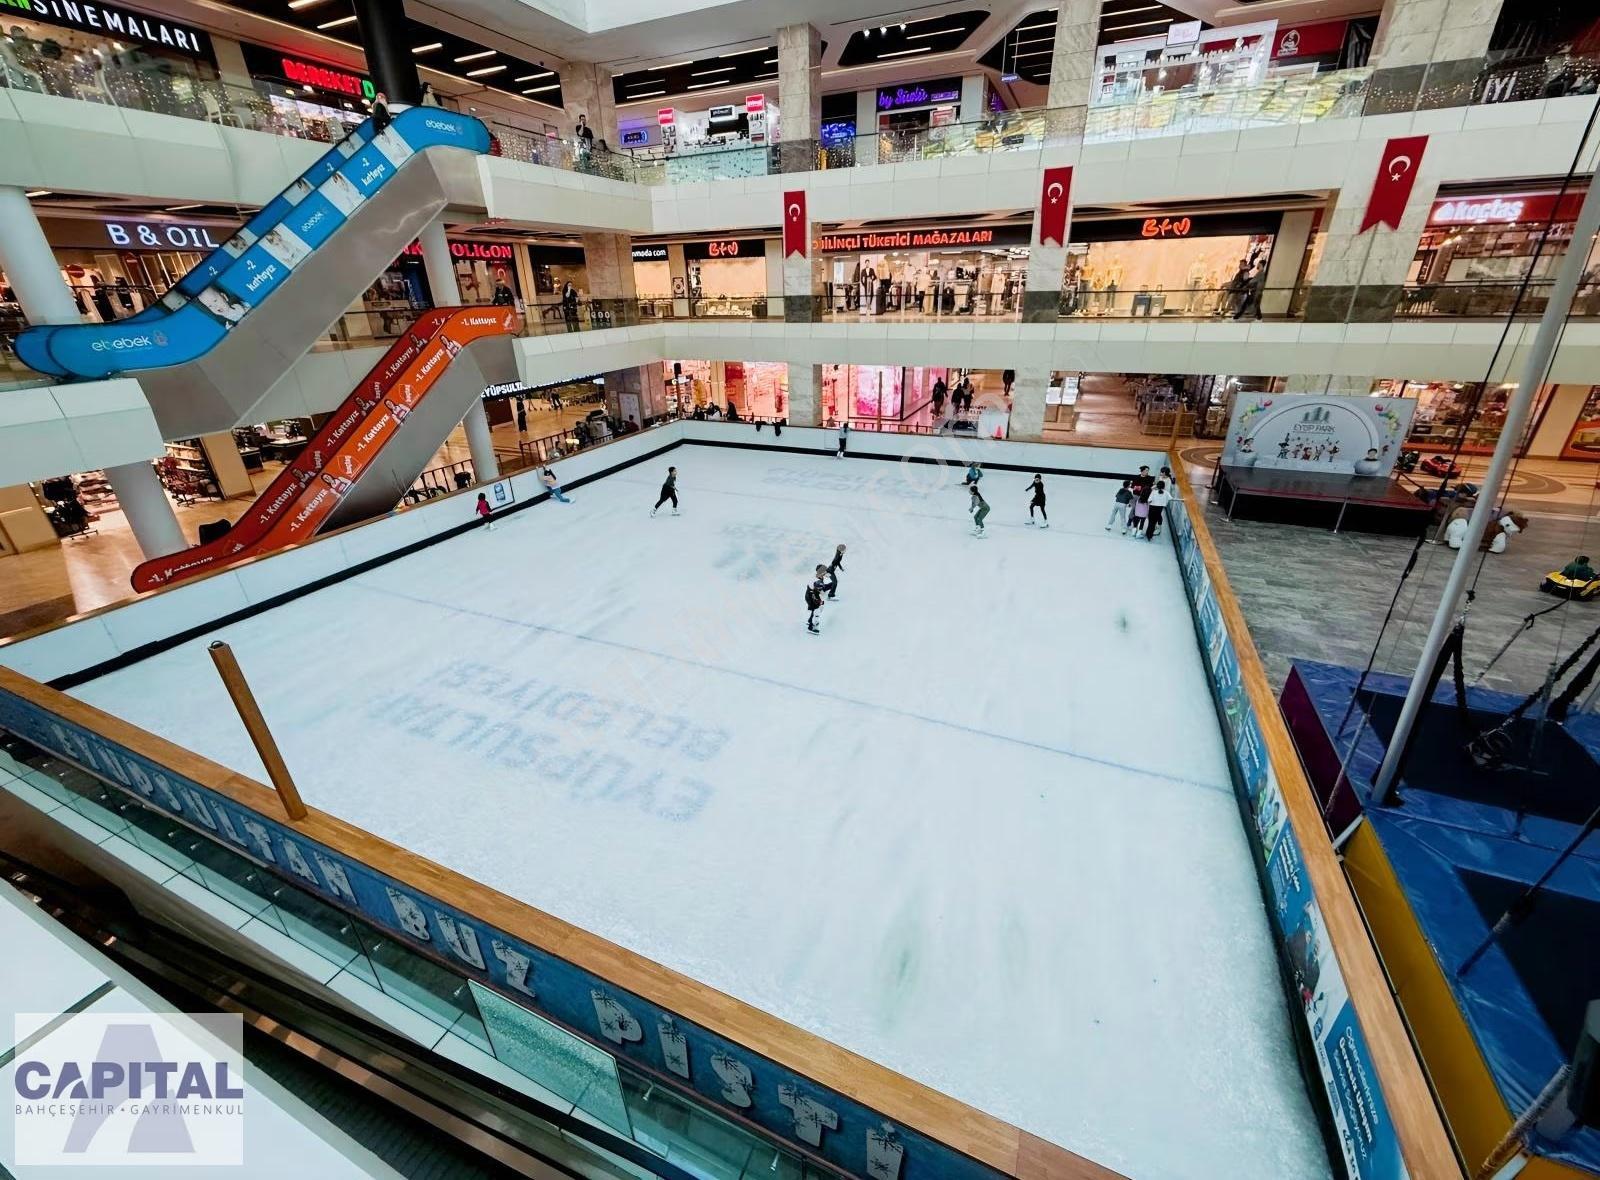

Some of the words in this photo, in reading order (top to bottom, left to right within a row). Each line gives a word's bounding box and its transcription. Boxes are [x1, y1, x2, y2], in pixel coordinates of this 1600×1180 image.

[106, 223, 130, 245] B
[166, 226, 220, 248] OIL
[862, 231, 911, 248] TÜKETİCİ
[912, 230, 992, 246] MAĞAZALARI
[267, 482, 298, 514] Kattayız
[297, 488, 328, 522] Kattayız
[386, 886, 537, 997] BUZ
